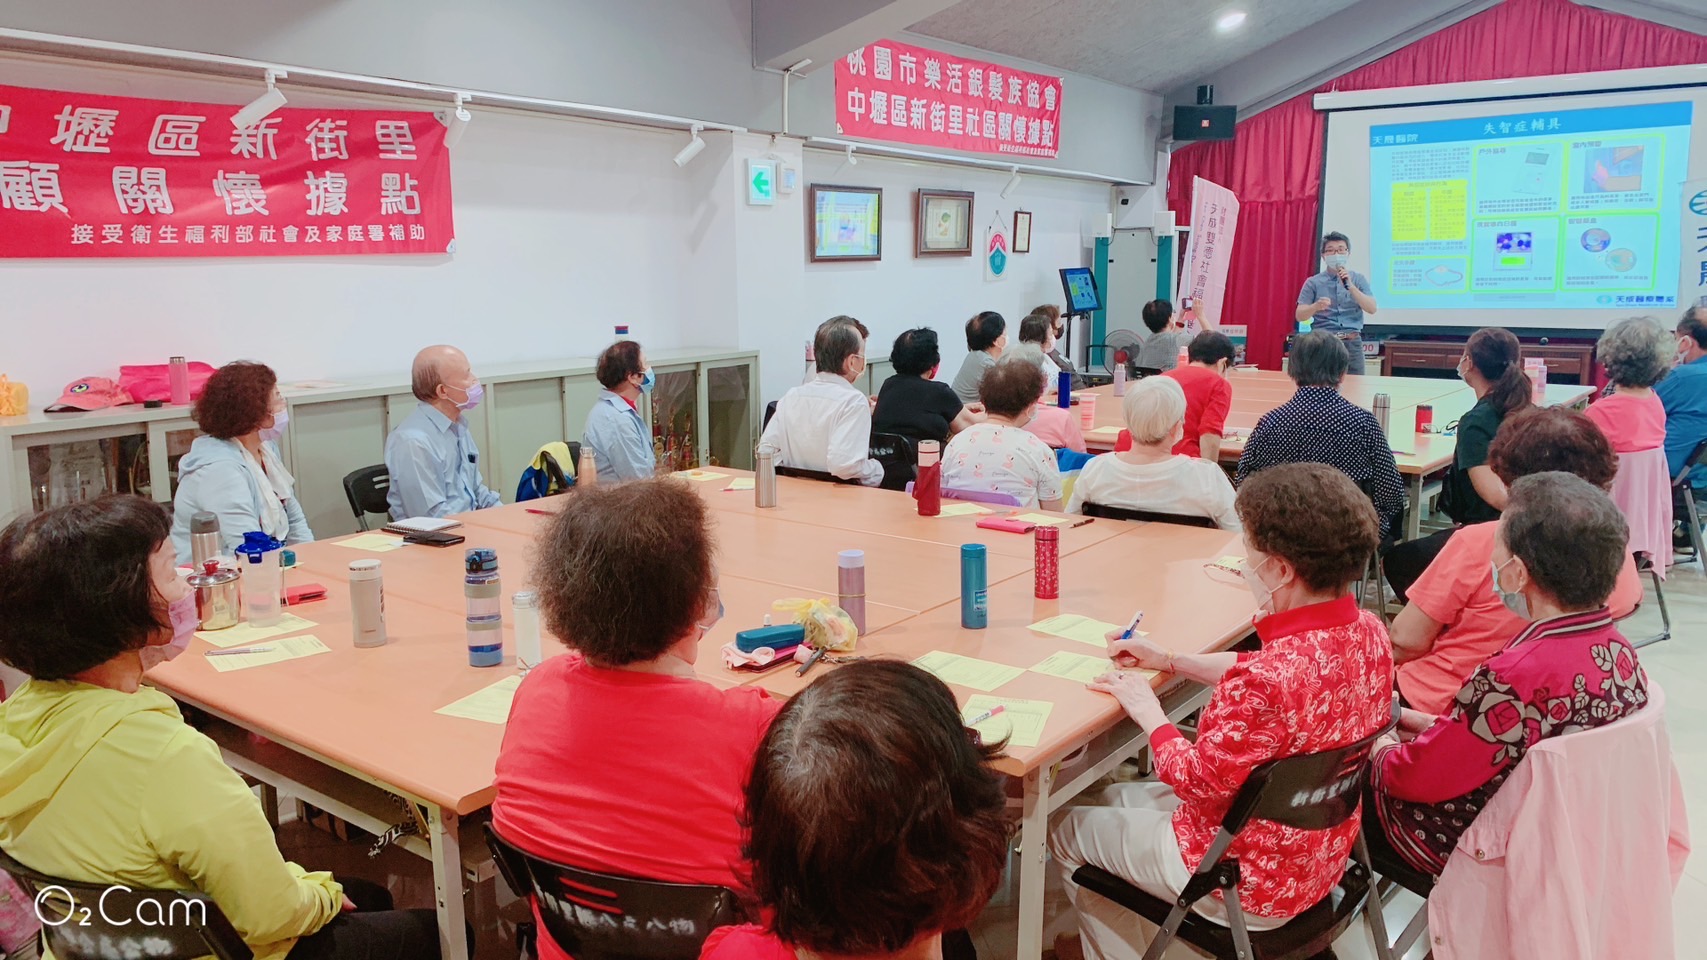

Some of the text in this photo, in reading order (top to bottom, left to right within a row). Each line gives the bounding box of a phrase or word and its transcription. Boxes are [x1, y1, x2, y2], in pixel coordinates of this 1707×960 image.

[847, 46, 1057, 111] 桃園市樂活銀髮族協會
[0, 104, 418, 161] 壢區新街里
[847, 87, 1054, 147] 中壢區新街里社區關懷據點
[1484, 117, 1561, 135] 失智症輔具
[71, 223, 426, 245] 接受衛生福利部社會及家庭署補助
